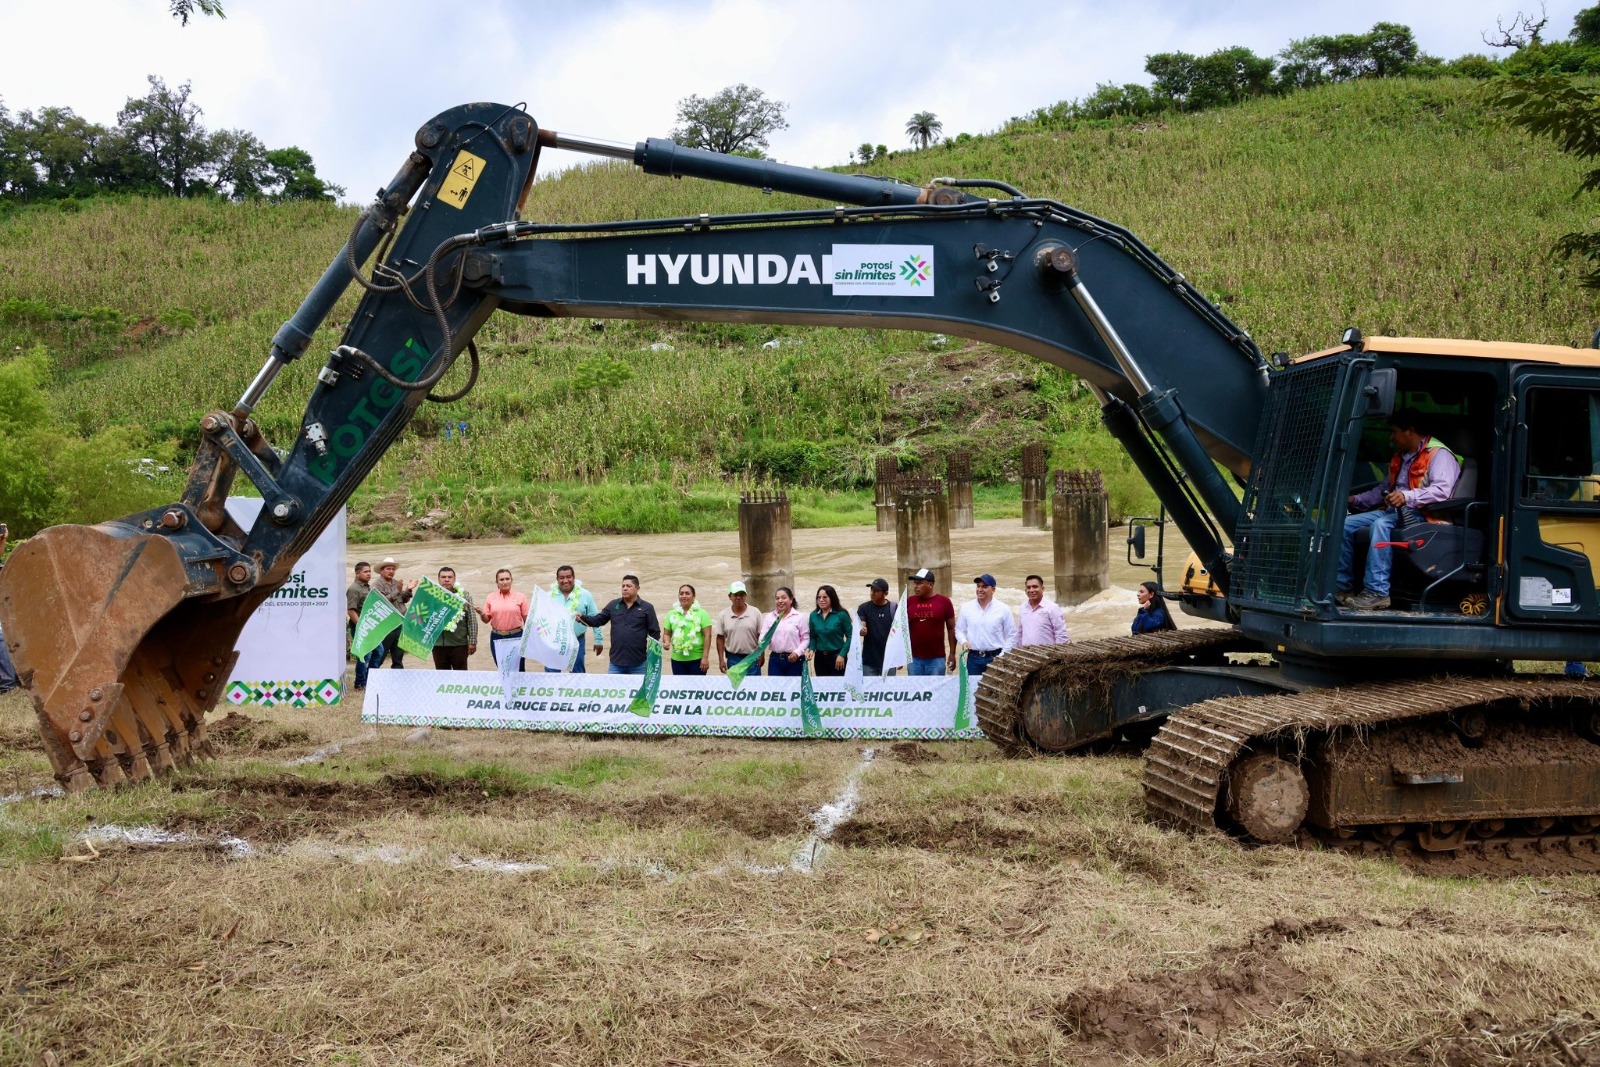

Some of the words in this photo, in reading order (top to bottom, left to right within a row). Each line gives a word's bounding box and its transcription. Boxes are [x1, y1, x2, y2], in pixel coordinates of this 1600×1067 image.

[627, 254, 832, 285] HYUNDAI
[834, 268, 853, 280] sin
[854, 268, 897, 280] límites
[529, 687, 555, 697] LOS
[558, 687, 627, 699] TRABAJOS
[656, 688, 757, 701] ONSTRUCCIÓN
[760, 691, 787, 702] DEL
[791, 691, 846, 702] PENTE
[851, 691, 933, 702] EHICULAR
[466, 699, 501, 710] PARA
[550, 701, 574, 712] DEL
[578, 700, 601, 713] RÍO
[663, 705, 682, 715] EN
[685, 705, 702, 715] LA
[706, 706, 787, 717] LOCALIDAD
